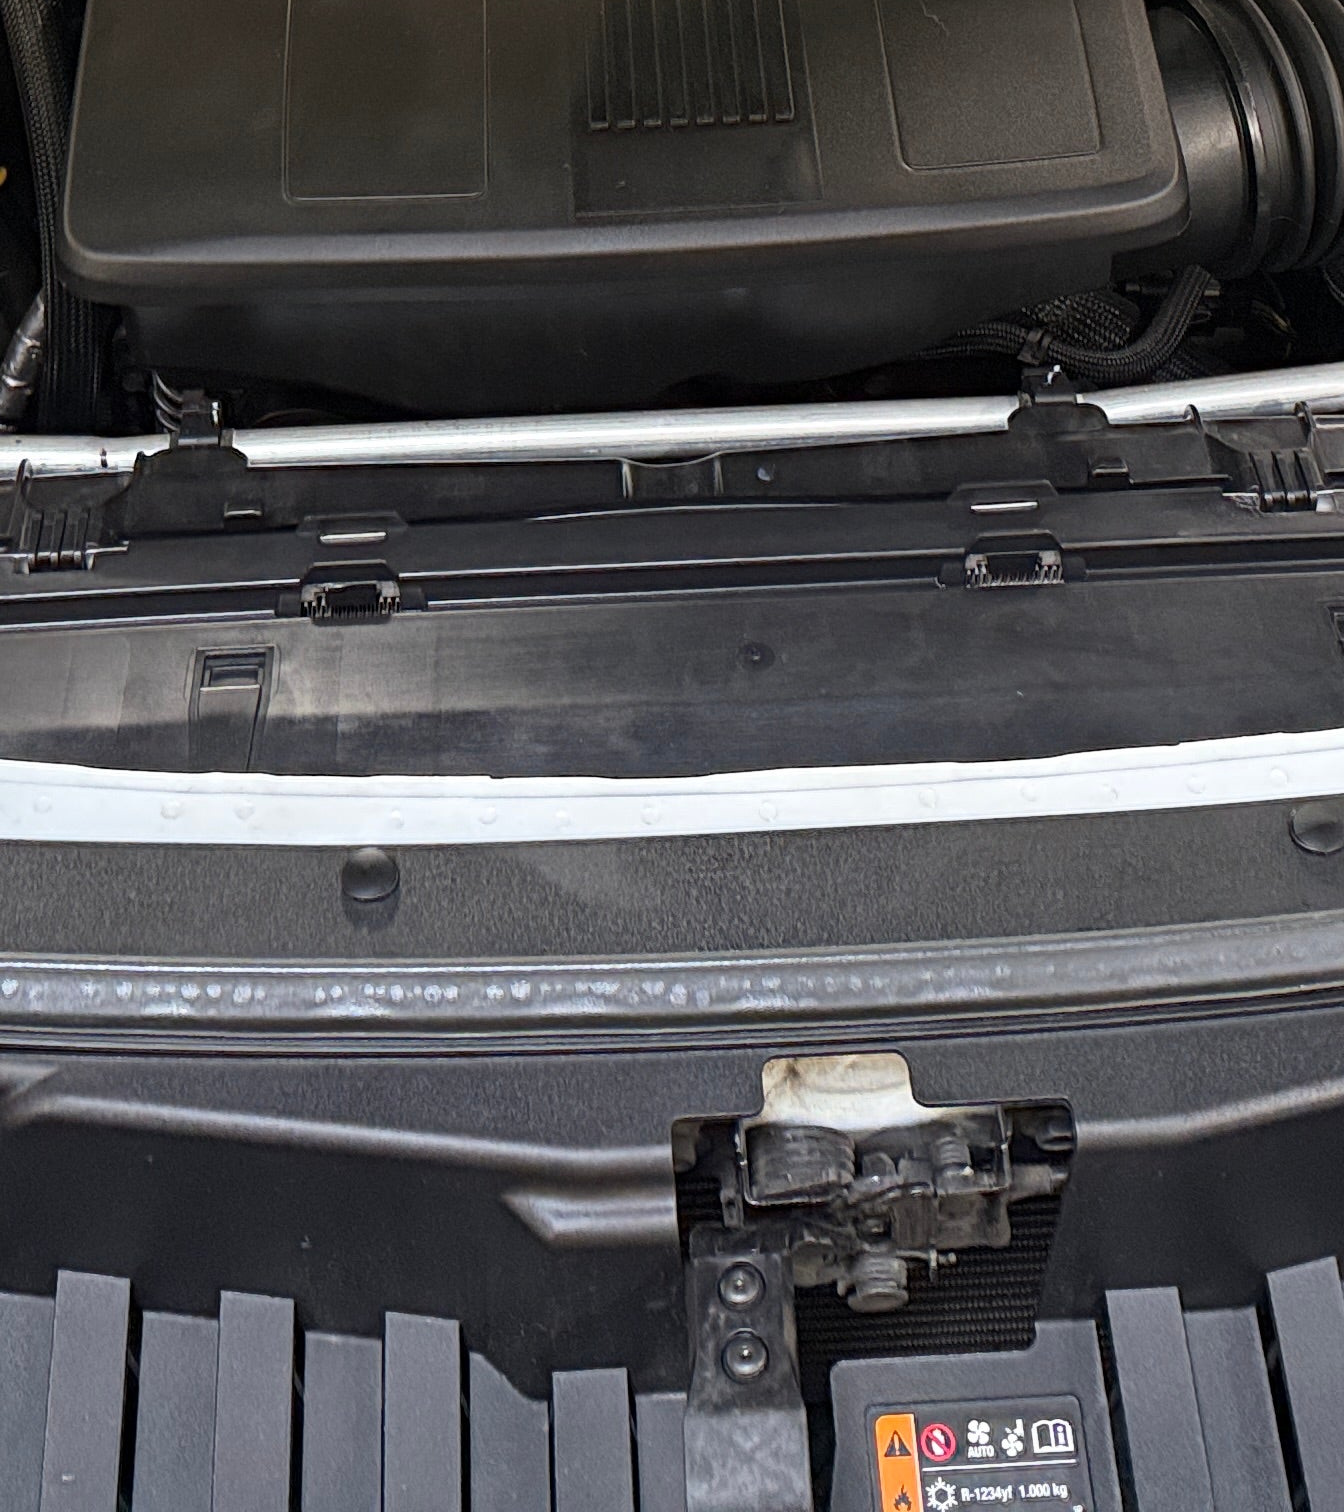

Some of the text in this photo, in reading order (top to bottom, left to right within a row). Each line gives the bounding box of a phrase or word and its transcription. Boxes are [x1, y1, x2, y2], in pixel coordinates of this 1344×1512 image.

[968, 1445, 995, 1458] AUTO
[961, 1483, 1069, 1502] R-1234yf 1.000 kg
